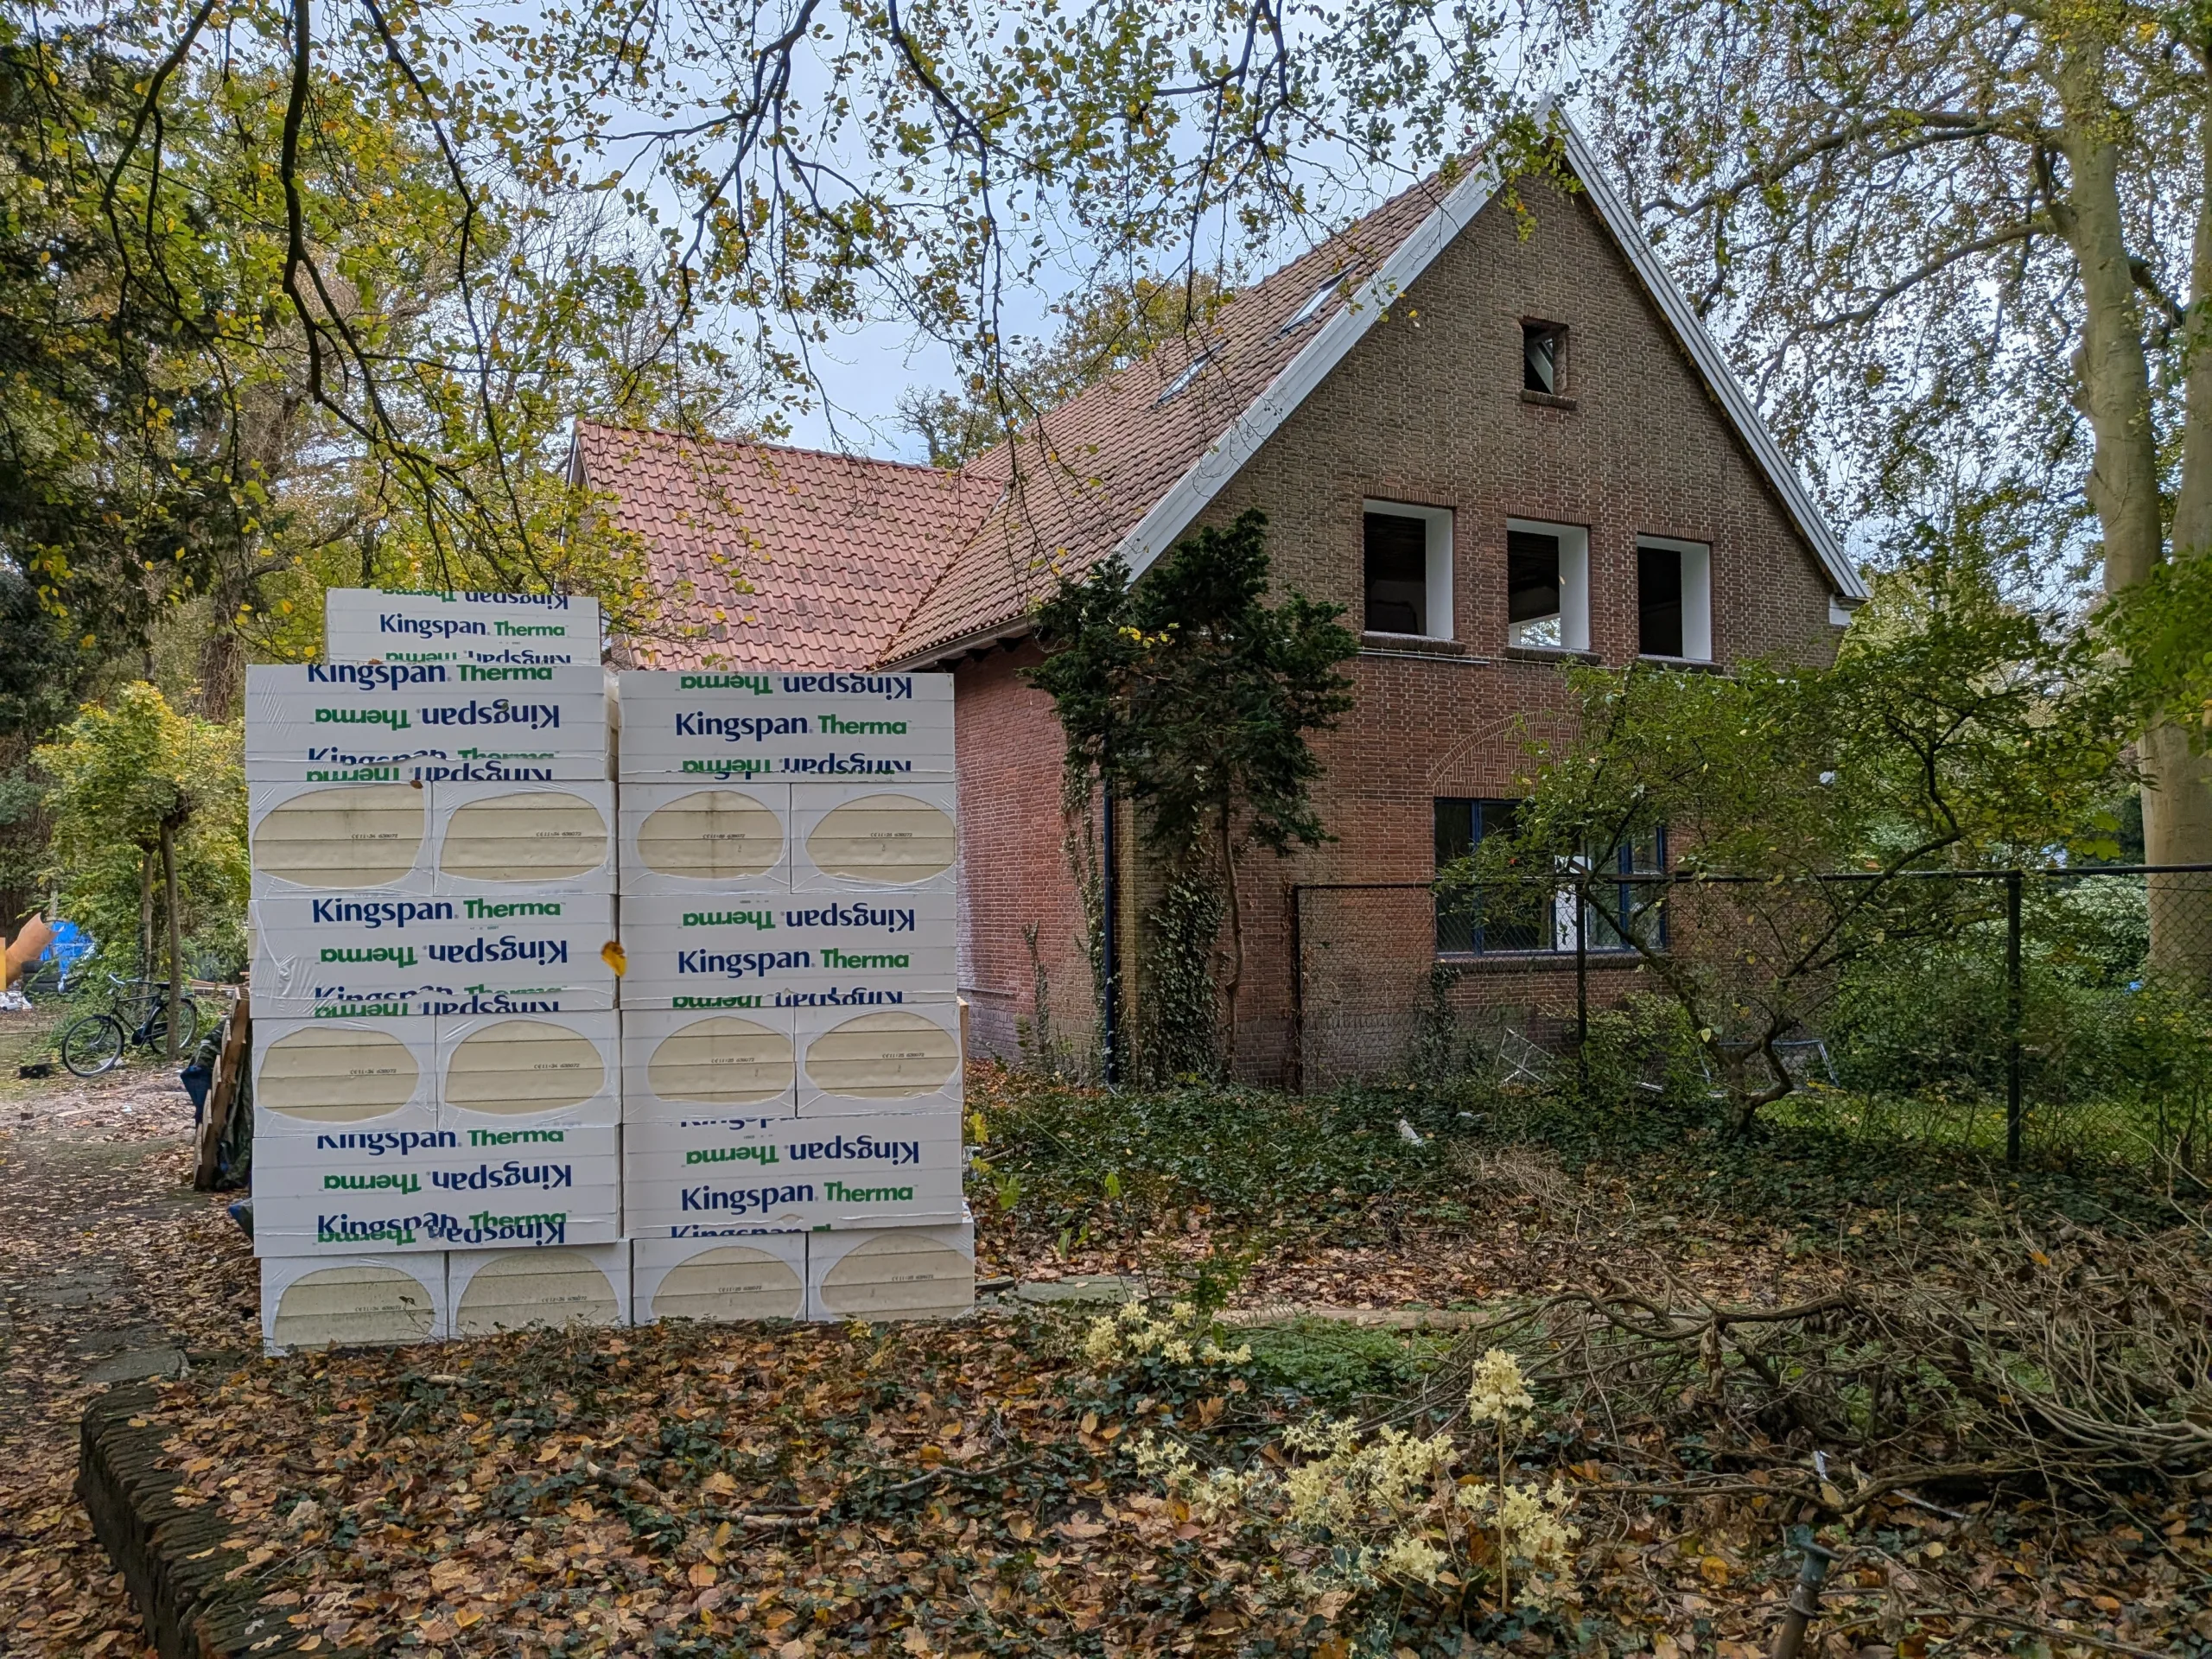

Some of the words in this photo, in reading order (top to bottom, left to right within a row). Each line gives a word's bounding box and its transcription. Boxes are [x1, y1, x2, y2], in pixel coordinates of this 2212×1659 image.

[380, 613, 486, 639] Kingspan
[493, 621, 565, 636] Therma
[308, 664, 446, 690] Kingspan
[456, 664, 553, 681] Therma
[680, 676, 773, 696] Therma
[784, 673, 912, 700] Kingspan
[315, 709, 411, 731] Therma
[422, 699, 560, 730] Kingspan
[676, 712, 807, 742] Kingspan
[817, 714, 907, 734] Therma
[312, 899, 453, 929] Kingspan
[463, 898, 561, 918] Therma
[683, 911, 775, 929] Therma
[786, 903, 915, 933] Kingspan
[321, 948, 417, 968] Therma
[429, 936, 568, 965] Kingspan
[678, 949, 810, 978] Kingspan
[820, 948, 909, 969] Therma
[467, 1129, 563, 1146] Therma
[790, 1135, 918, 1165] Kingspan
[686, 1145, 779, 1166] Therma
[324, 1174, 422, 1195] Therma
[433, 1161, 572, 1191] Kingspan
[682, 1185, 813, 1214] Kingspan
[824, 1182, 912, 1202] Therma
[469, 1211, 566, 1230] Therma
